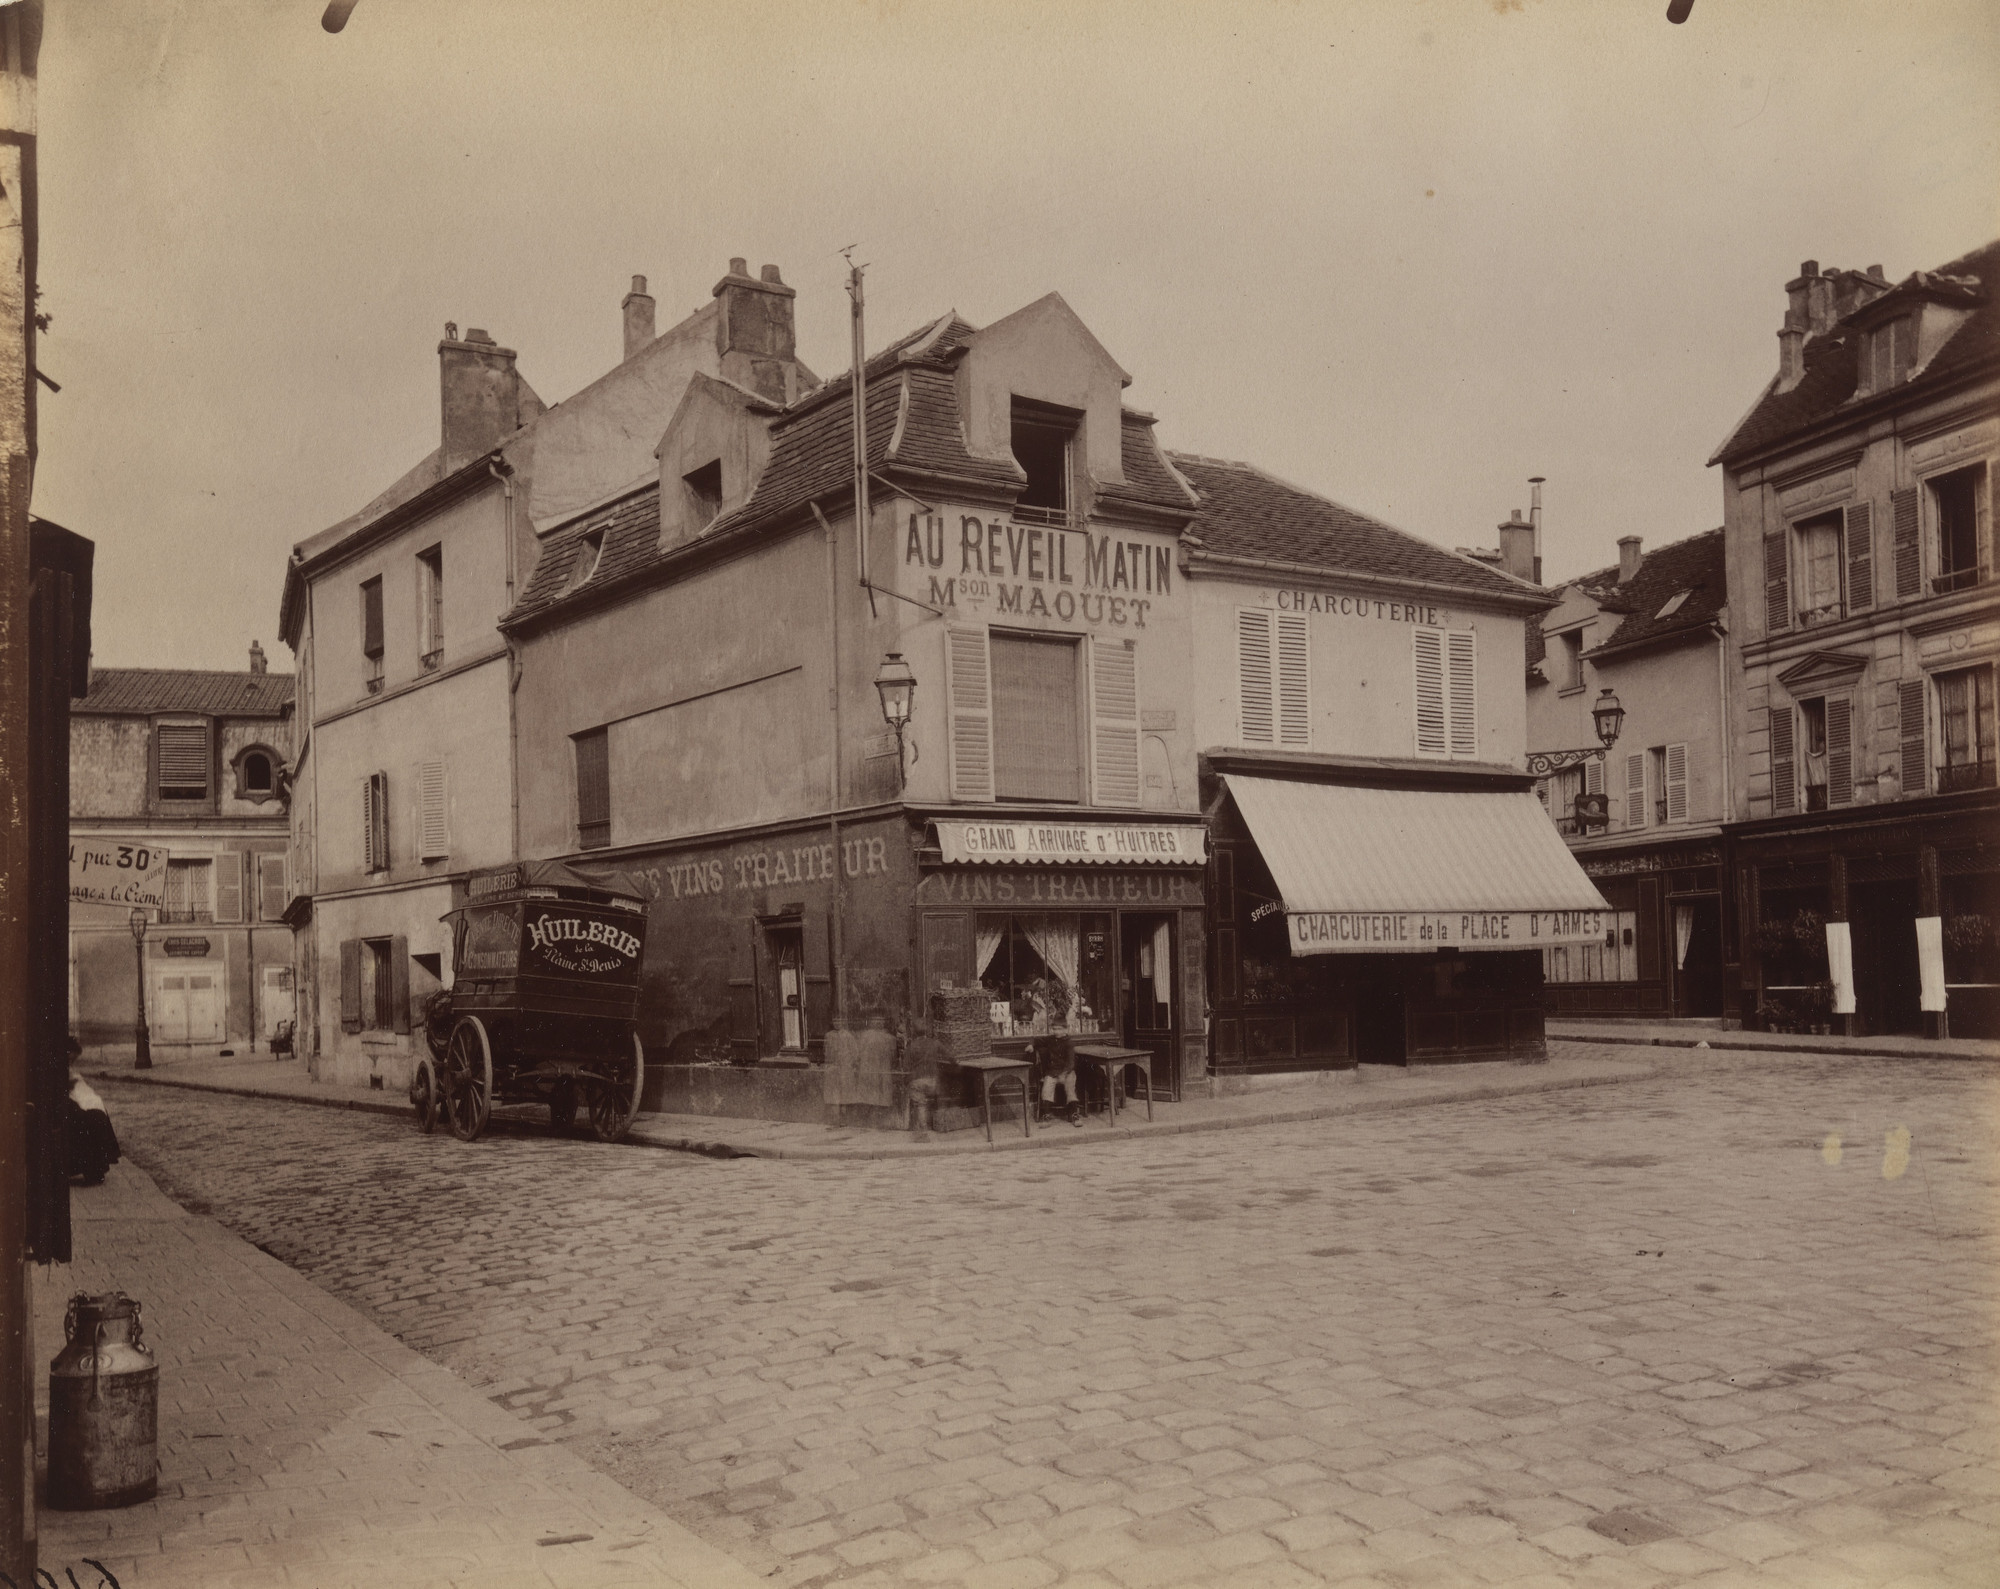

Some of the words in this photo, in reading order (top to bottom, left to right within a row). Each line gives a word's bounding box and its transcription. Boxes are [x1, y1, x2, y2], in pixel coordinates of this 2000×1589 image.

[906, 513, 944, 569] AU
[960, 514, 1073, 584] RÉVEIL
[1084, 532, 1172, 595] MATIN
[1277, 590, 1438, 626] CHARCUTERIE
[965, 827, 1016, 851] GRAND
[1028, 828, 1088, 852] ARRIVAGE
[667, 860, 724, 898] VINS
[733, 837, 887, 890] TRAITEUR
[69, 886, 96, 902] age
[111, 885, 121, 901] la
[469, 872, 517, 896] HUILERIE
[1025, 874, 1187, 901] TRAITEUR
[527, 914, 641, 959] HUILERIE
[1297, 914, 1408, 942] CHARCUTERIE
[1420, 916, 1434, 940] de
[1437, 919, 1448, 940] la
[1462, 914, 1511, 940] PLACE
[542, 948, 578, 971] Plaine
[575, 944, 583, 953] de
[584, 943, 594, 952] la
